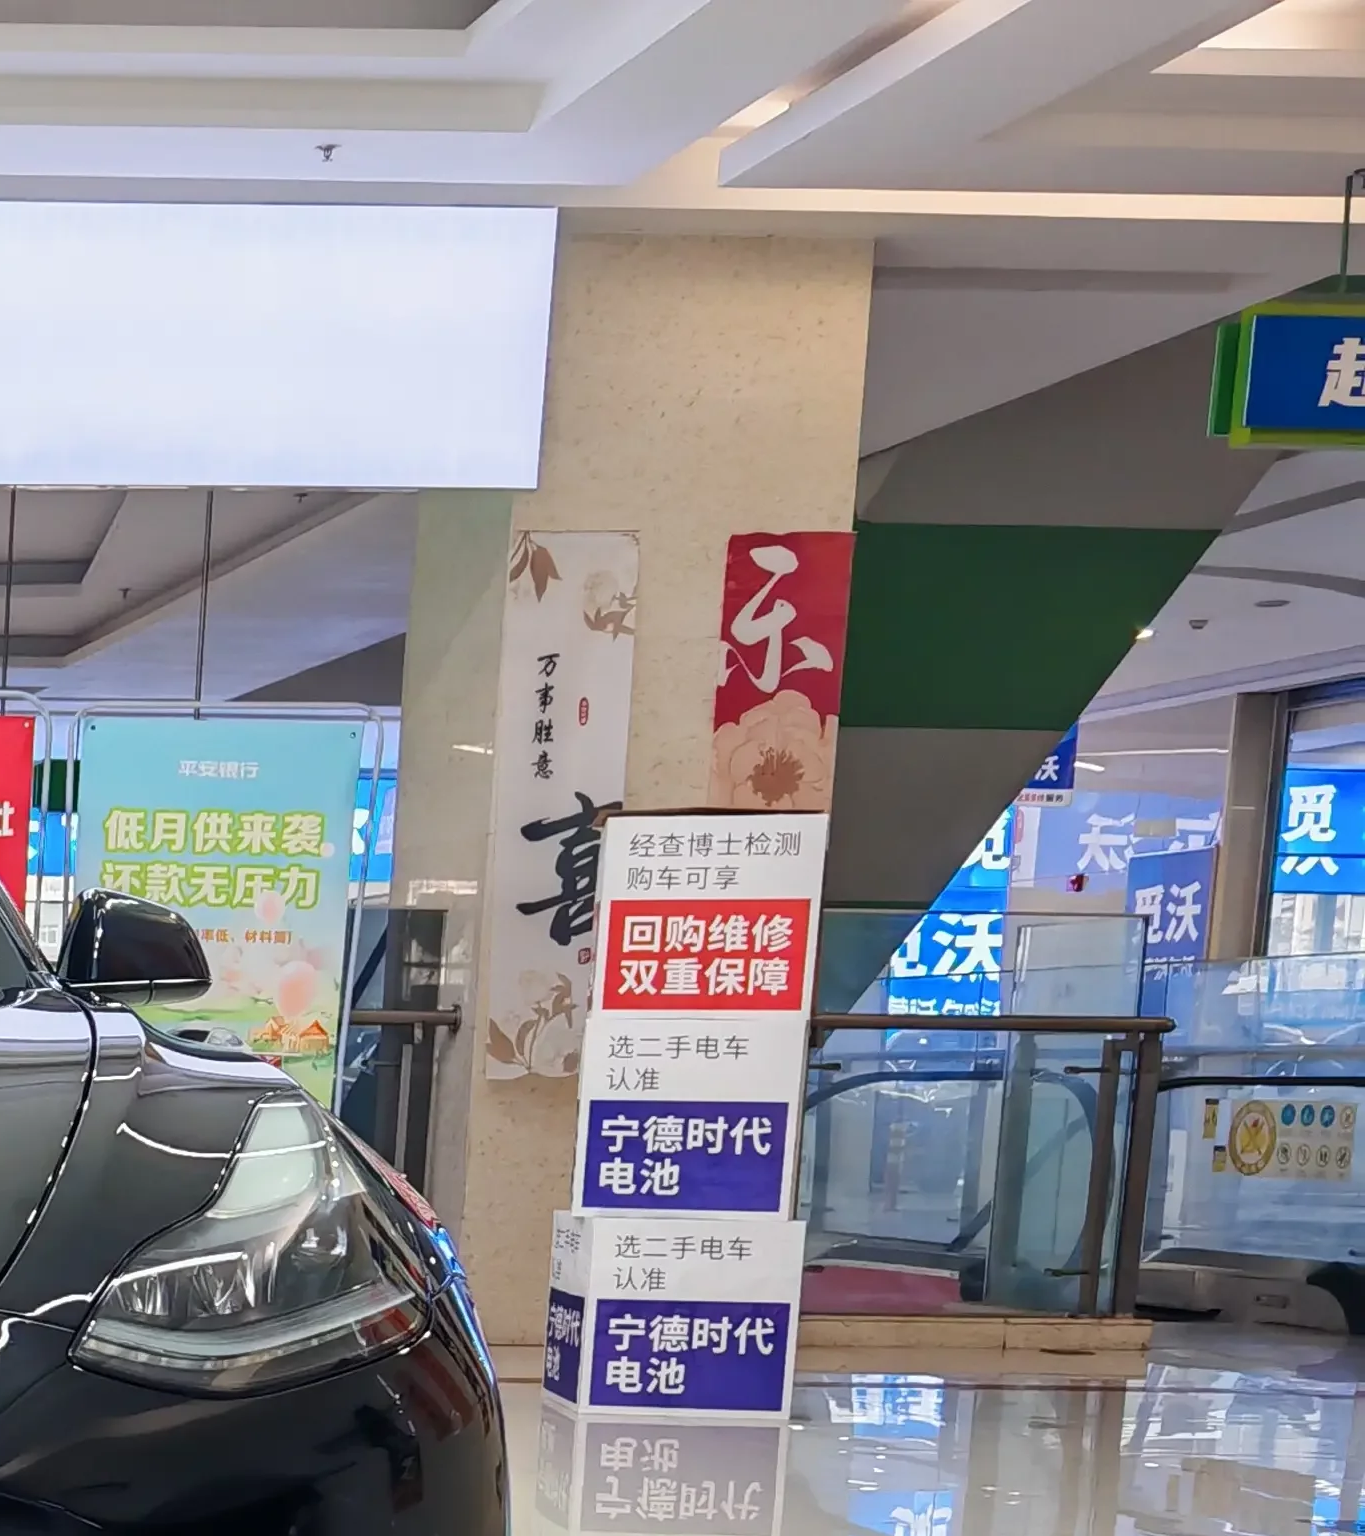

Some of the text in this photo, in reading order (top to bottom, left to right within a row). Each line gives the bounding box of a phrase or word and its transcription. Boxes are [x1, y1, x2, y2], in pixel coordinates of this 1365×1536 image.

[717, 545, 835, 693] 乐
[530, 652, 561, 781] 万事胜意
[178, 759, 260, 779] 平安银行
[104, 808, 324, 856] 低月供来袭
[628, 830, 803, 860] 经查博士检测
[102, 860, 319, 908] 还款无压力
[626, 865, 741, 891] 购车可享
[621, 912, 795, 955] 回购维修
[616, 956, 791, 998] 双重保障
[607, 1033, 751, 1061] 选二手电车
[606, 1066, 662, 1093] 认准
[600, 1115, 774, 1157] 宁德时代
[597, 1157, 681, 1199] 电池
[613, 1233, 754, 1262] 选二手电车
[612, 1265, 668, 1293] 认准
[606, 1314, 776, 1356] 宁德时代
[604, 1356, 686, 1397] 电池
